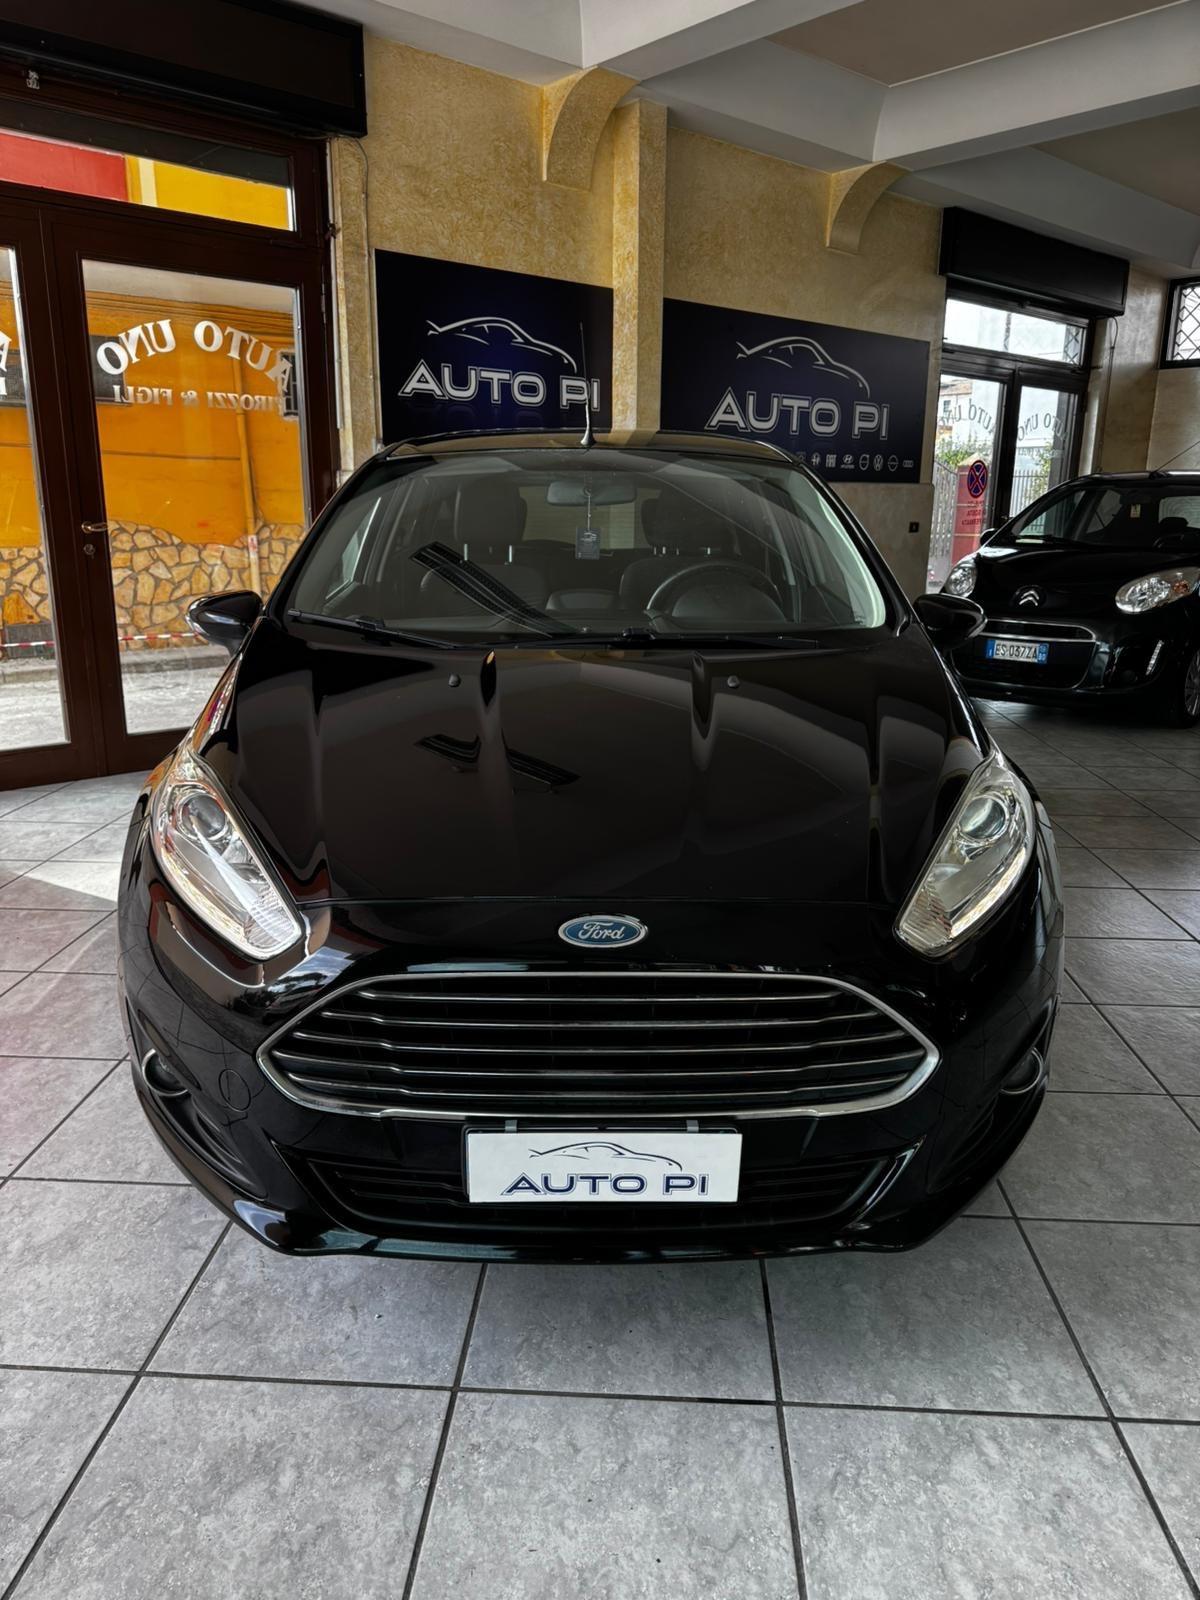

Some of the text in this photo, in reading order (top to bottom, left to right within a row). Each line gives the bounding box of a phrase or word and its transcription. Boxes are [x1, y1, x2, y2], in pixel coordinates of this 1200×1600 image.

[398, 359, 600, 411] AUTO PI
[704, 386, 890, 440] AUTO PI
[578, 921, 625, 940] Ford
[500, 1172, 709, 1196] AUTO PI
